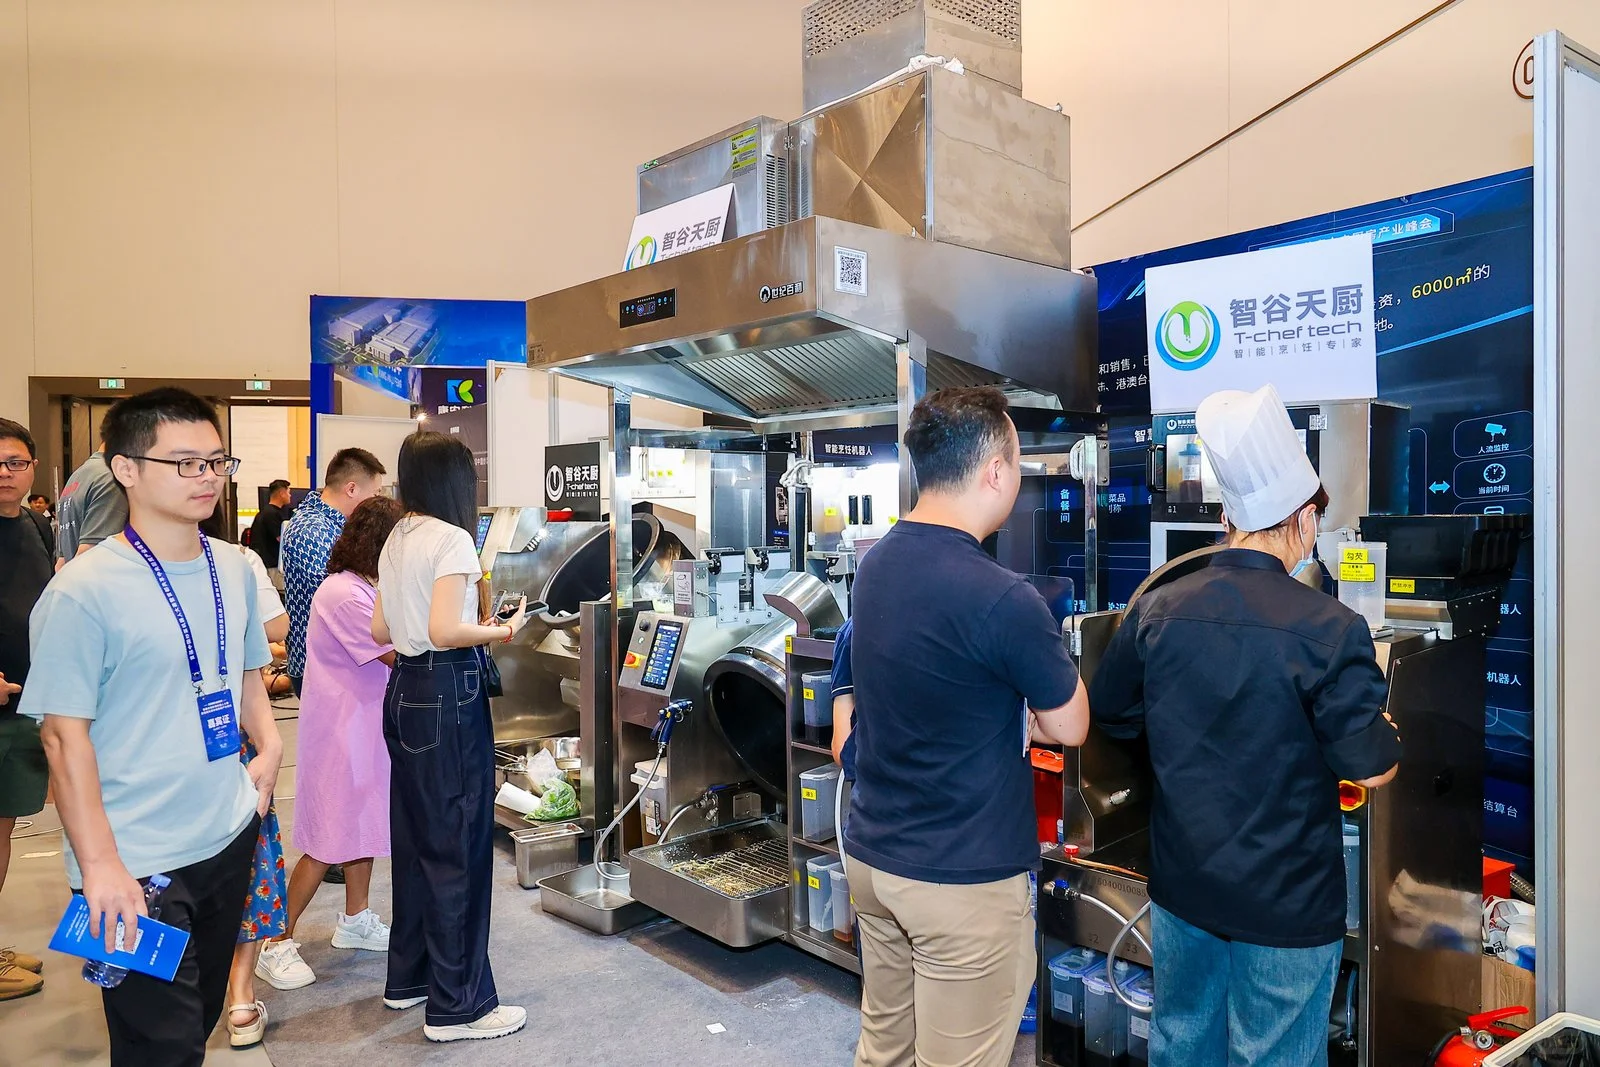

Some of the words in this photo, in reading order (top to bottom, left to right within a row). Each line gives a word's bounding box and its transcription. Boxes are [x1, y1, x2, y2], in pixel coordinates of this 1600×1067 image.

[662, 216, 721, 252] 智谷天厨
[1230, 284, 1363, 328] 智谷天厨
[1309, 321, 1362, 337] tech
[824, 443, 873, 456] 智能烹饪机器人
[1478, 443, 1510, 454] 人流监控
[565, 465, 599, 482] 智谷天厨
[1346, 552, 1363, 561] 勾芡
[1486, 671, 1522, 686] 机器人
[1484, 799, 1518, 818] 结算台
